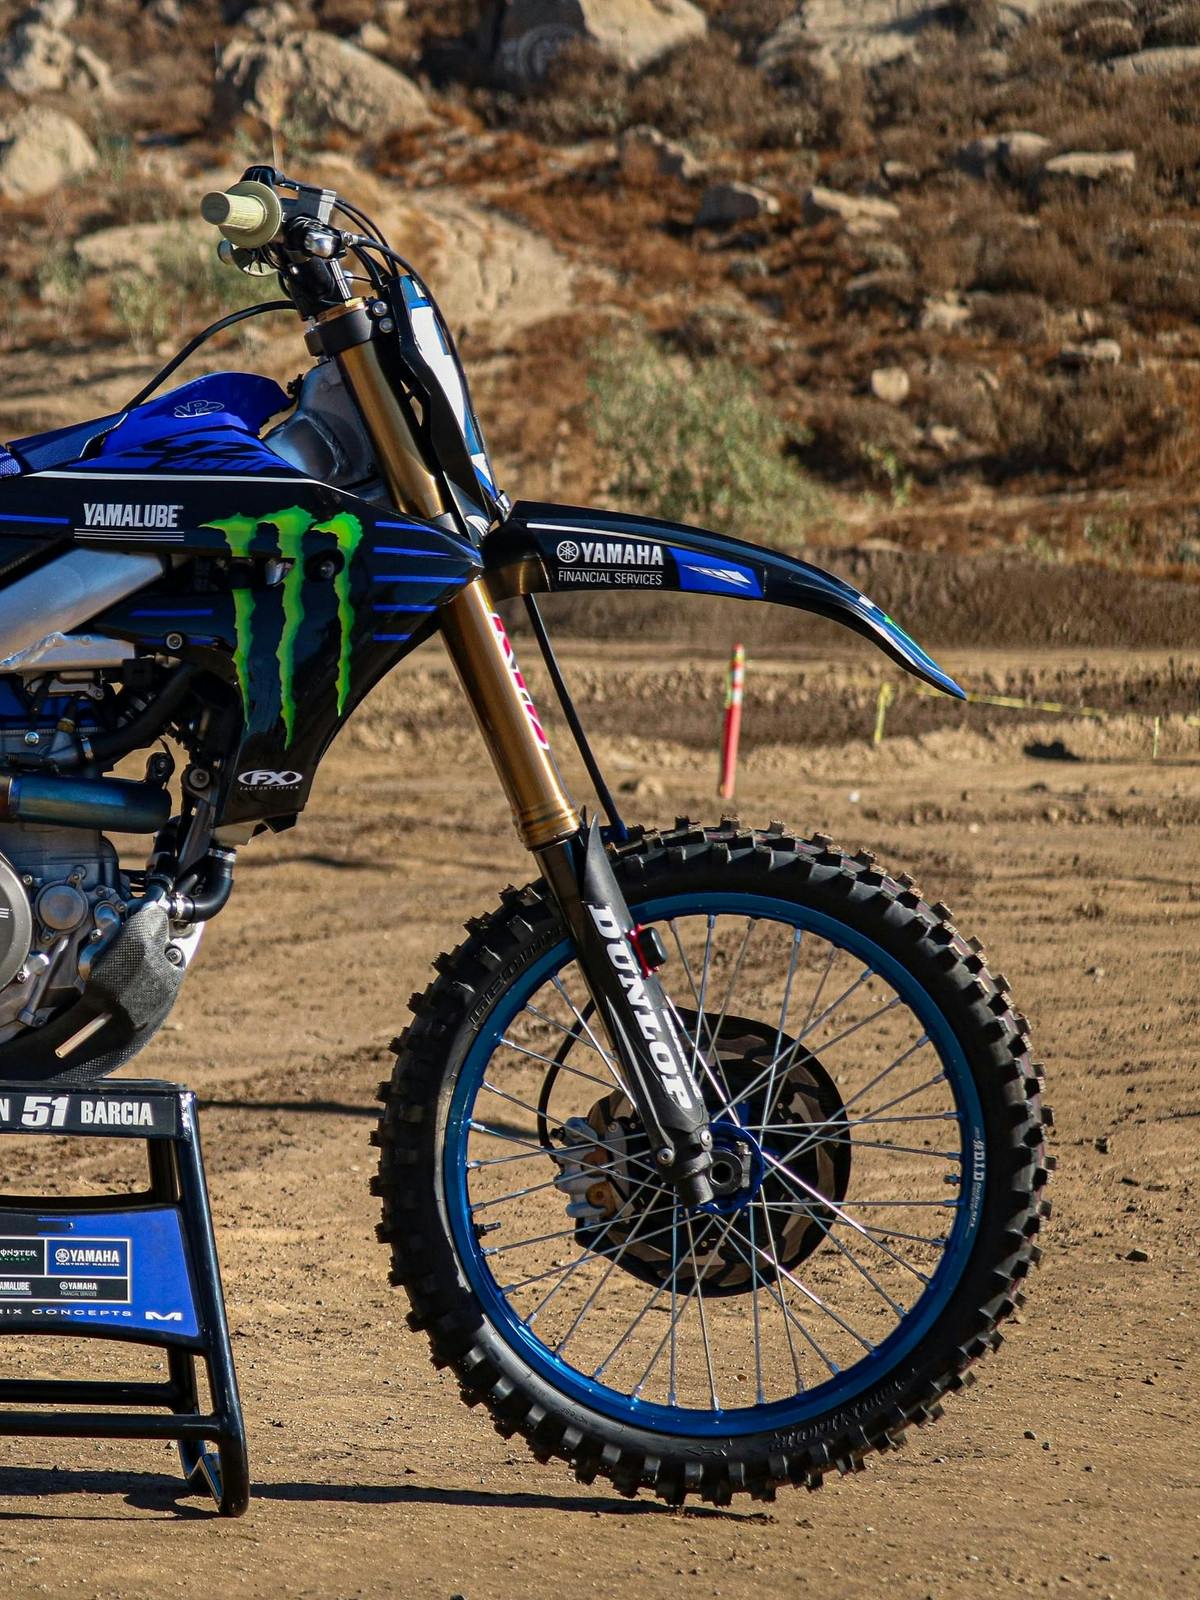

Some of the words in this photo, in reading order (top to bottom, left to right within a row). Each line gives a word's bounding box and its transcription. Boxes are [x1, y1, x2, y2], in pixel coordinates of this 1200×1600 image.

[83, 503, 179, 528] YAMALUBE
[580, 542, 665, 566] YAMAHA
[558, 570, 612, 583] FINANCIAL
[614, 572, 663, 585] SERVICES
[248, 769, 292, 786] FX
[587, 904, 693, 1110] DUNLOP
[21, 1095, 69, 1127] 51
[80, 1100, 154, 1126] BARCIA
[70, 1249, 120, 1263] YAMAHA
[68, 1281, 98, 1291] YAMAHA
[31, 1308, 133, 1317] CONCEPTS
